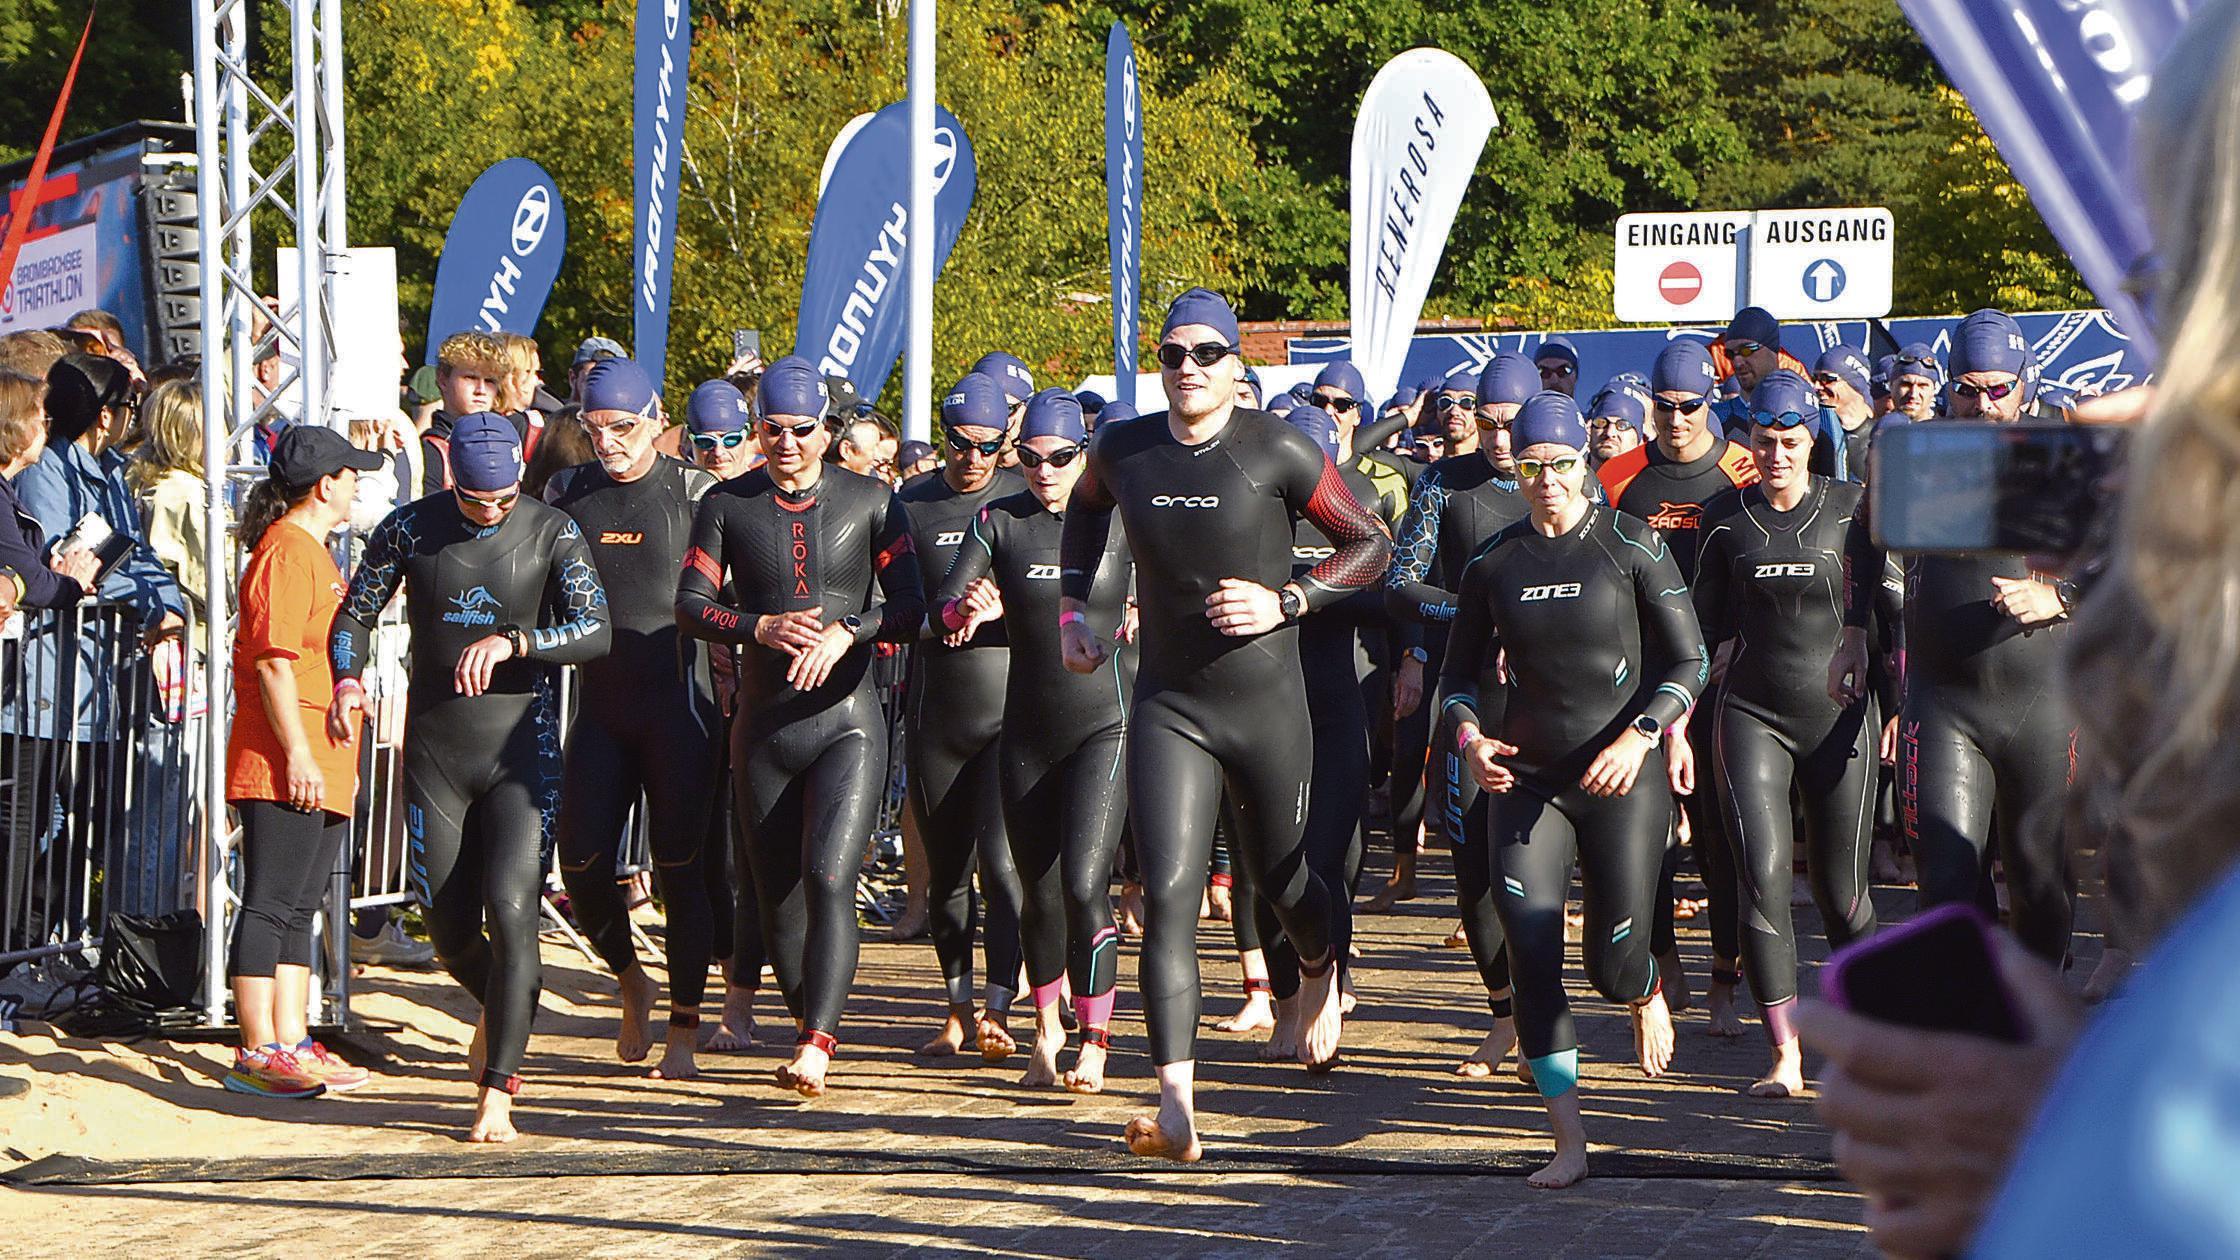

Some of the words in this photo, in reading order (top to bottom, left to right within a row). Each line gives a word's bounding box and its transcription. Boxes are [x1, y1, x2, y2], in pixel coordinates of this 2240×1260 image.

[1375, 90, 1445, 303] RENÉROSA
[1628, 222, 1736, 247] EINGANG
[1766, 218, 1887, 244] AUSGANG
[17, 249, 82, 286] BROMBACHSEE
[17, 273, 83, 313] TRIATHLON
[1151, 495, 1220, 508] orca
[600, 531, 643, 544] 2XU
[1754, 562, 1816, 579] ZONE3
[1519, 581, 1583, 602] ZONE3
[442, 609, 497, 629] sailfish
